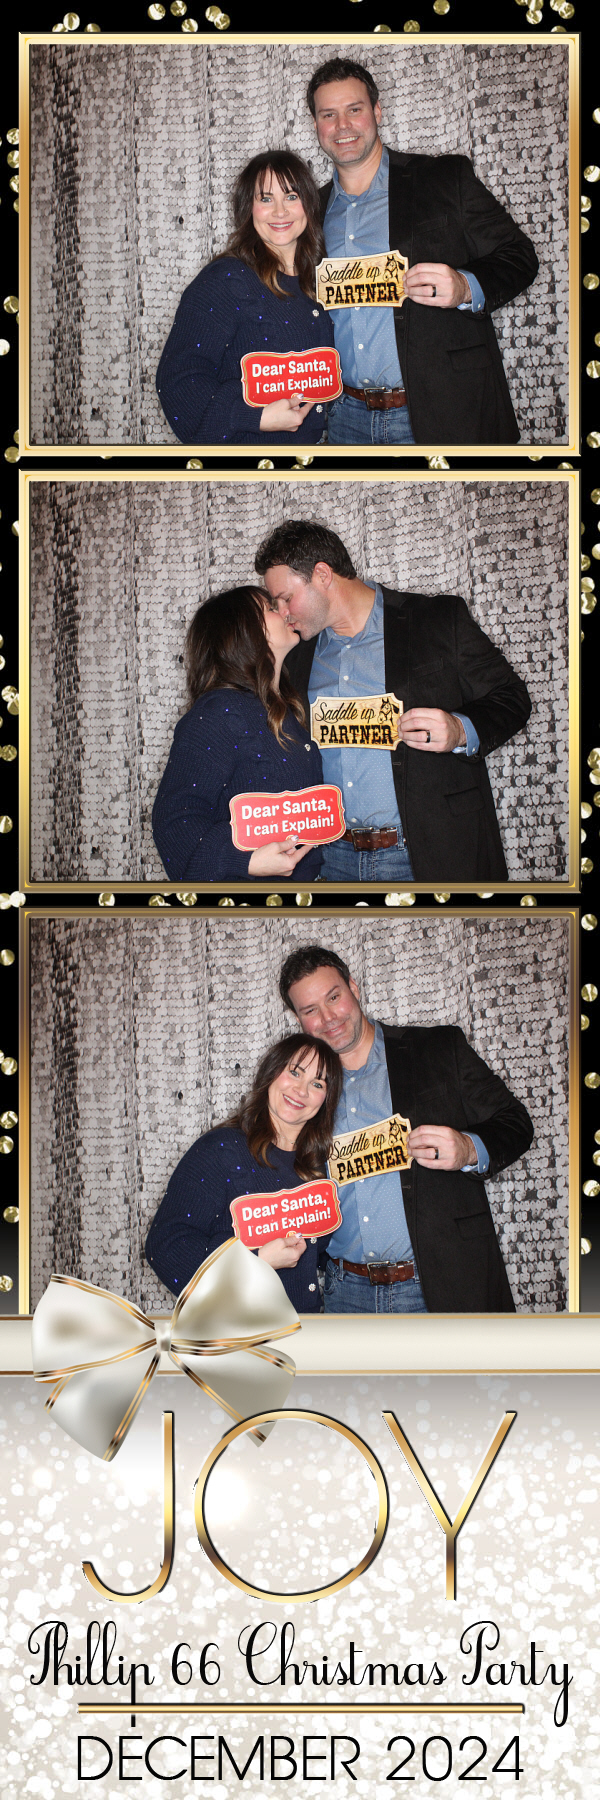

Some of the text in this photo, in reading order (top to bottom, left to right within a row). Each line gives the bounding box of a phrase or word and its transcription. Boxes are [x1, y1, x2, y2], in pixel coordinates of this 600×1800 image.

[320, 262, 381, 284] Saddle up
[325, 282, 400, 304] PARTNER
[252, 359, 331, 377] Dear Santa,
[255, 375, 333, 394] I can Explain!
[315, 702, 376, 724] Saddle up
[320, 724, 393, 744] PARTNER
[241, 798, 331, 819] Dear Santa,
[246, 814, 334, 837] I can Explain!
[330, 1132, 387, 1160] Saddle up
[337, 1145, 407, 1181] PARTNER
[242, 1193, 327, 1221] Dear Santa,
[247, 1207, 331, 1237] I can Explain!
